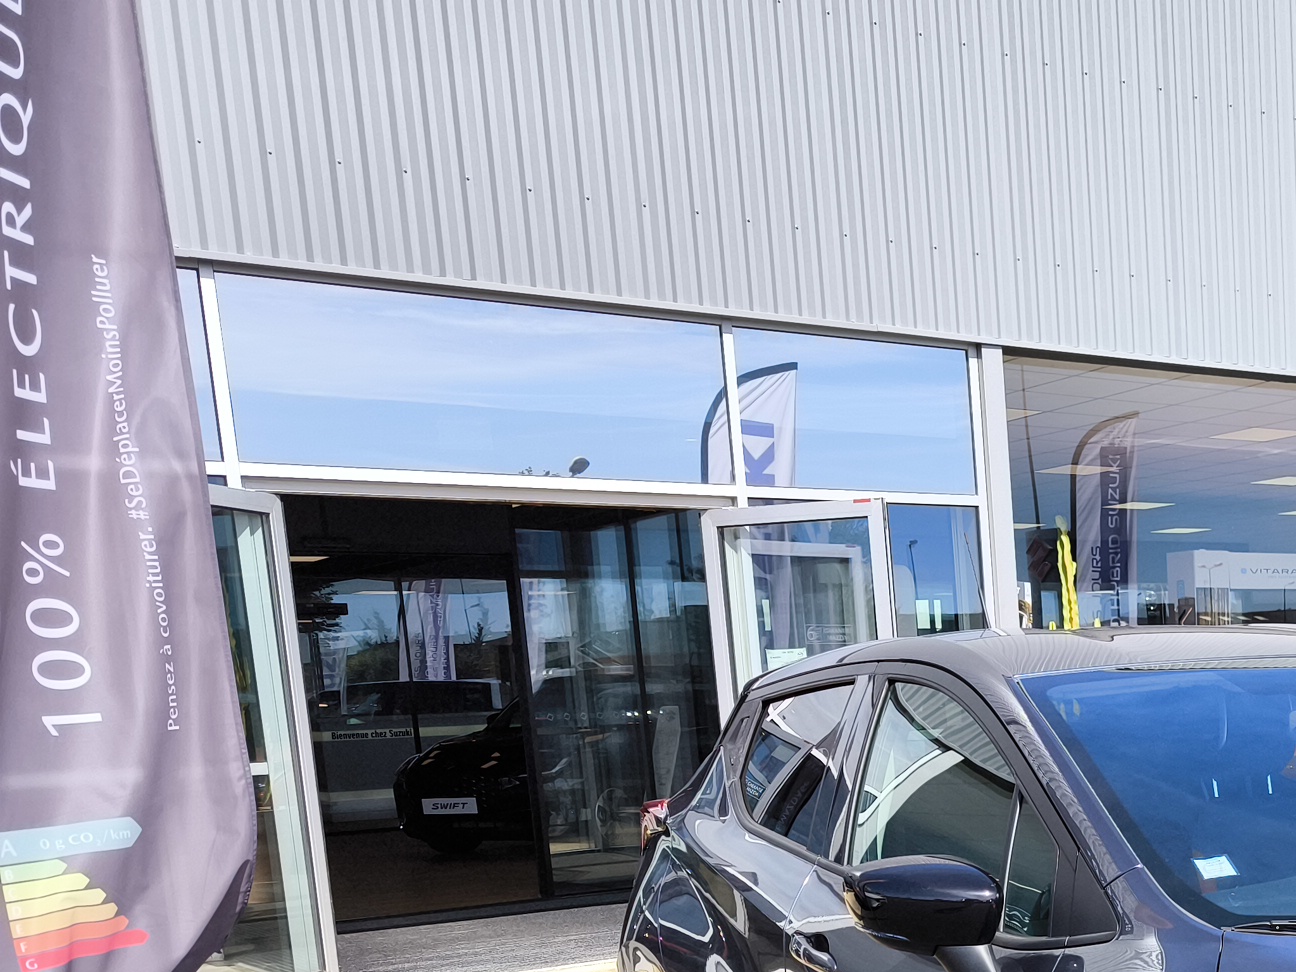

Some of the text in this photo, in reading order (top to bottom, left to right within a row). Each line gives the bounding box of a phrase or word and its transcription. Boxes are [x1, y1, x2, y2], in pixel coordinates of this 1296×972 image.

[91, 254, 181, 731] Pensez à covoiturer. #SeDéplacerMoinsPolluer
[1108, 454, 1121, 528] SUZUKI
[331, 728, 413, 740] Bienvenue chez Suzuki
[431, 802, 468, 810] SWIFT
[39, 838, 50, 850] 0
[55, 839, 66, 851] g
[19, 941, 28, 953] F
[25, 958, 39, 970] G
